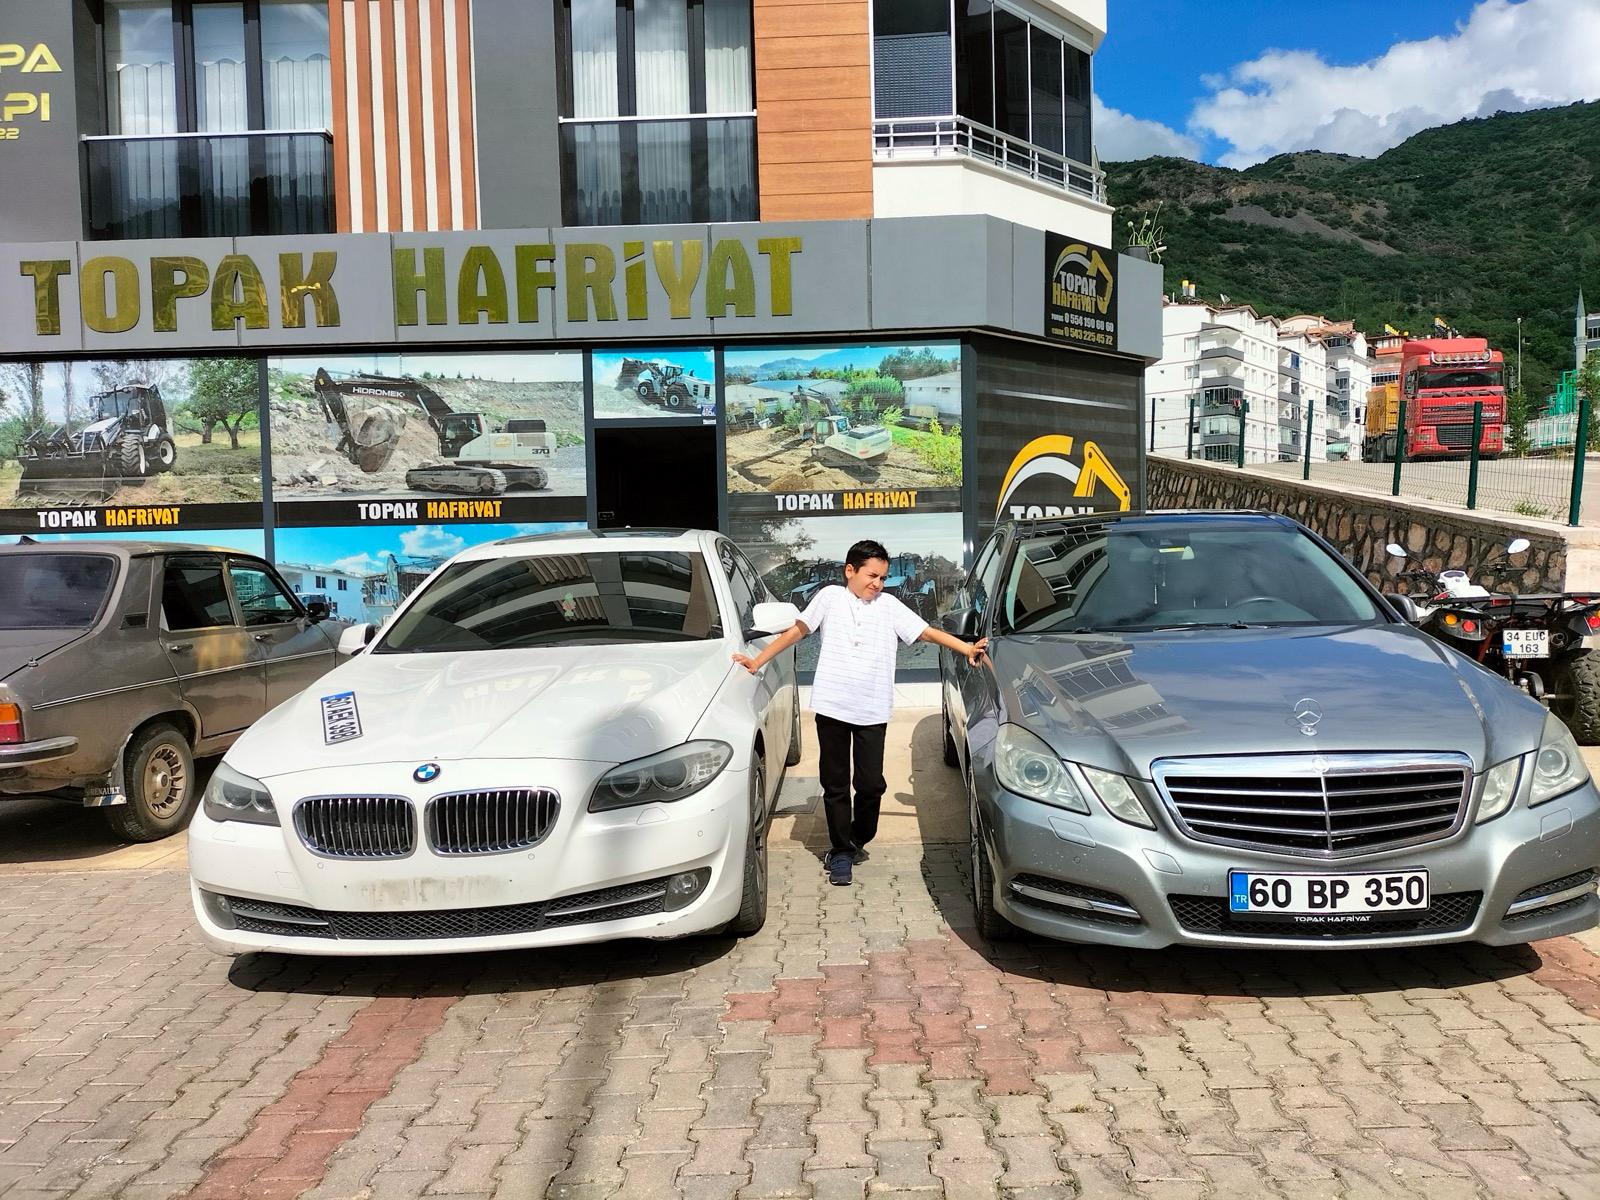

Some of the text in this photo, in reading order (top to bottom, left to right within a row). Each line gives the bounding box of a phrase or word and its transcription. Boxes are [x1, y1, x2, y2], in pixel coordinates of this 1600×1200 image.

[20, 251, 341, 335] TOPAK
[1059, 270, 1097, 297] TOPAK
[1065, 313, 1070, 323] 0
[357, 502, 418, 521] TOPAK
[775, 493, 834, 512] TOPAK
[37, 509, 97, 528] TOPAK
[1506, 631, 1520, 642] 34
[1519, 643, 1539, 653] 163
[327, 706, 355, 726] AEK
[329, 721, 358, 740] 398
[1234, 875, 1425, 909] TR 60 BP 350
